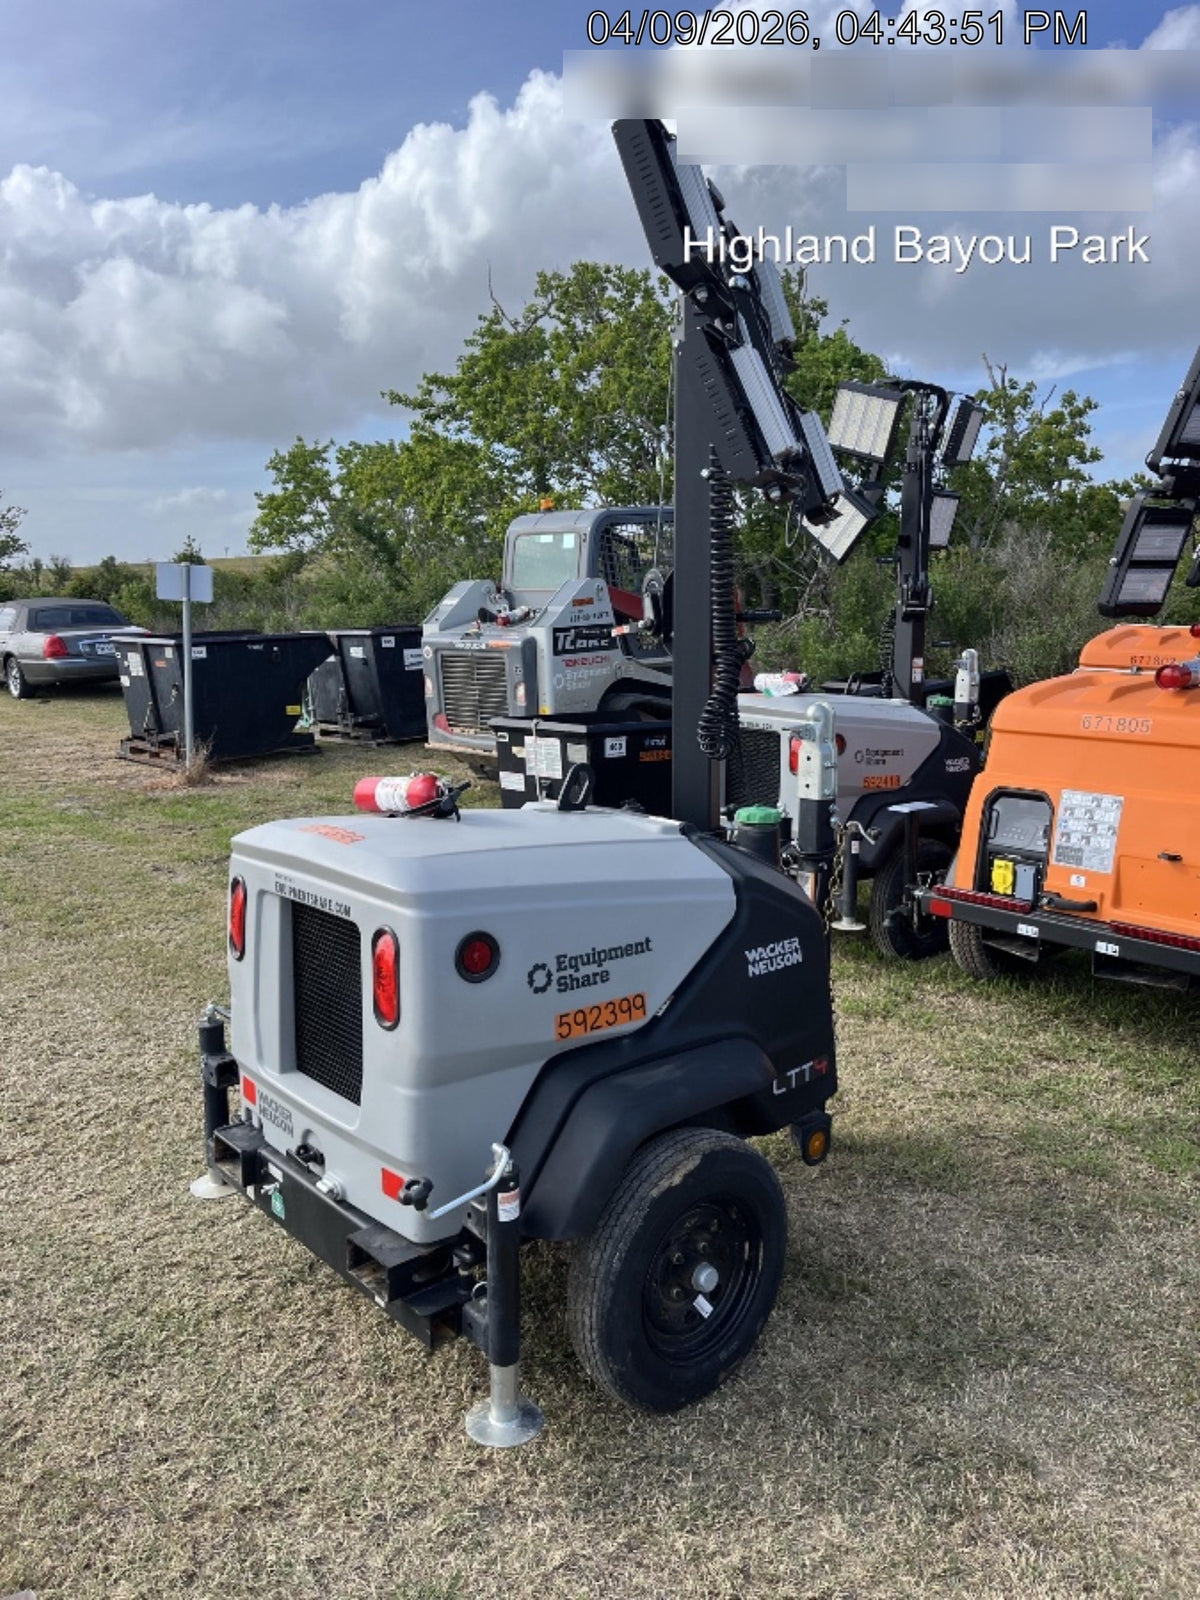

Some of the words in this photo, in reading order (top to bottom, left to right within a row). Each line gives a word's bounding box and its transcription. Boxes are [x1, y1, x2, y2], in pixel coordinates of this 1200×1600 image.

[1082, 715, 1151, 734] 671805
[555, 936, 653, 973] Equipment
[745, 936, 801, 963] WACKER
[748, 949, 803, 978] NEUSON
[555, 969, 611, 993] Share
[557, 993, 646, 1039] 592399
[772, 1058, 829, 1095] LTT4
